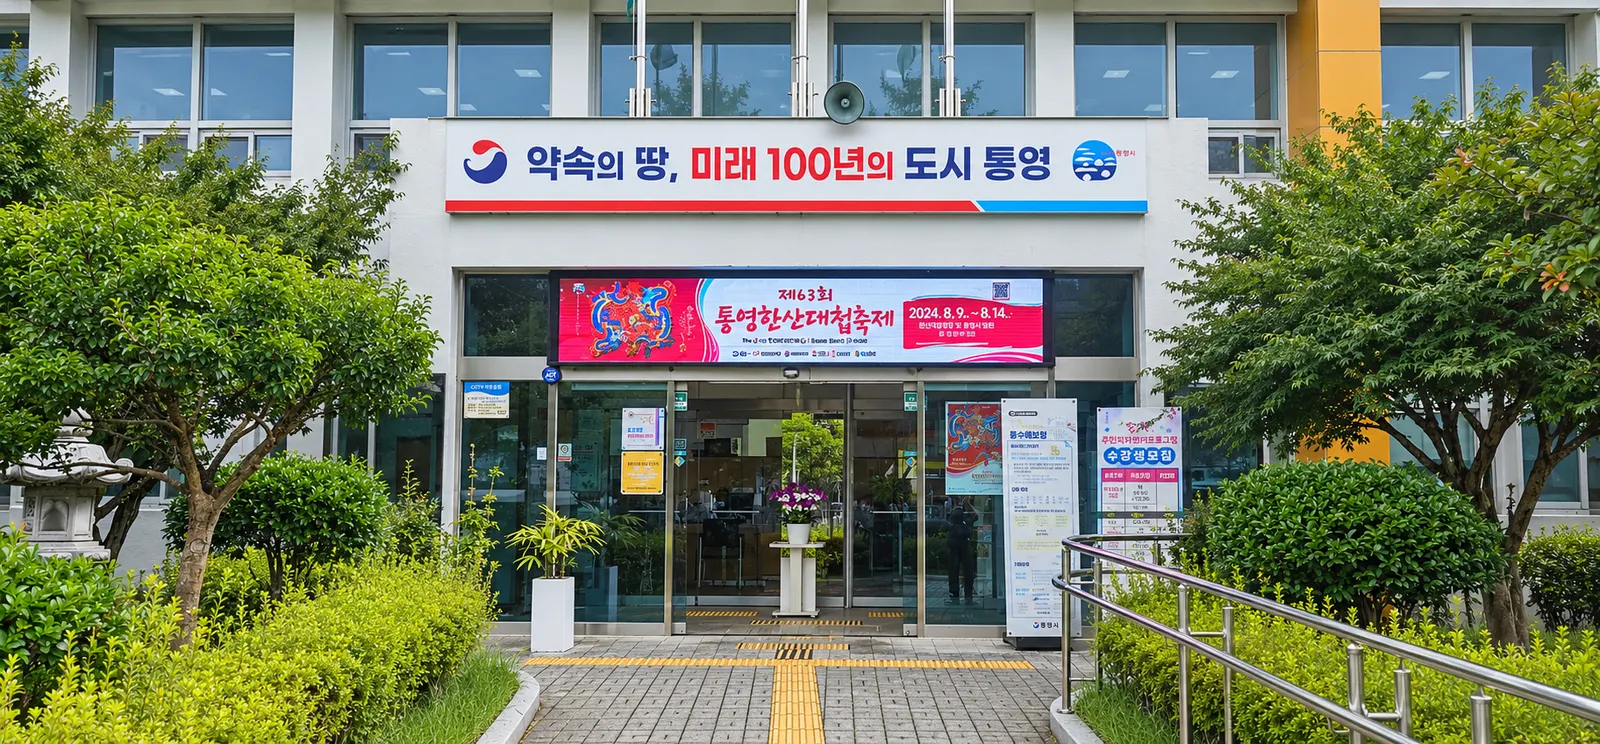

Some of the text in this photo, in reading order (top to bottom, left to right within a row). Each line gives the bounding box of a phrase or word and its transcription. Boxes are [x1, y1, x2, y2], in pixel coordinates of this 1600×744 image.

[527, 146, 1051, 183] 약속의 땅, 미래 100년의 도시 통영
[778, 285, 833, 302] 제63회
[715, 304, 895, 335] 통영한산대첩축제
[908, 307, 942, 319] 2024.
